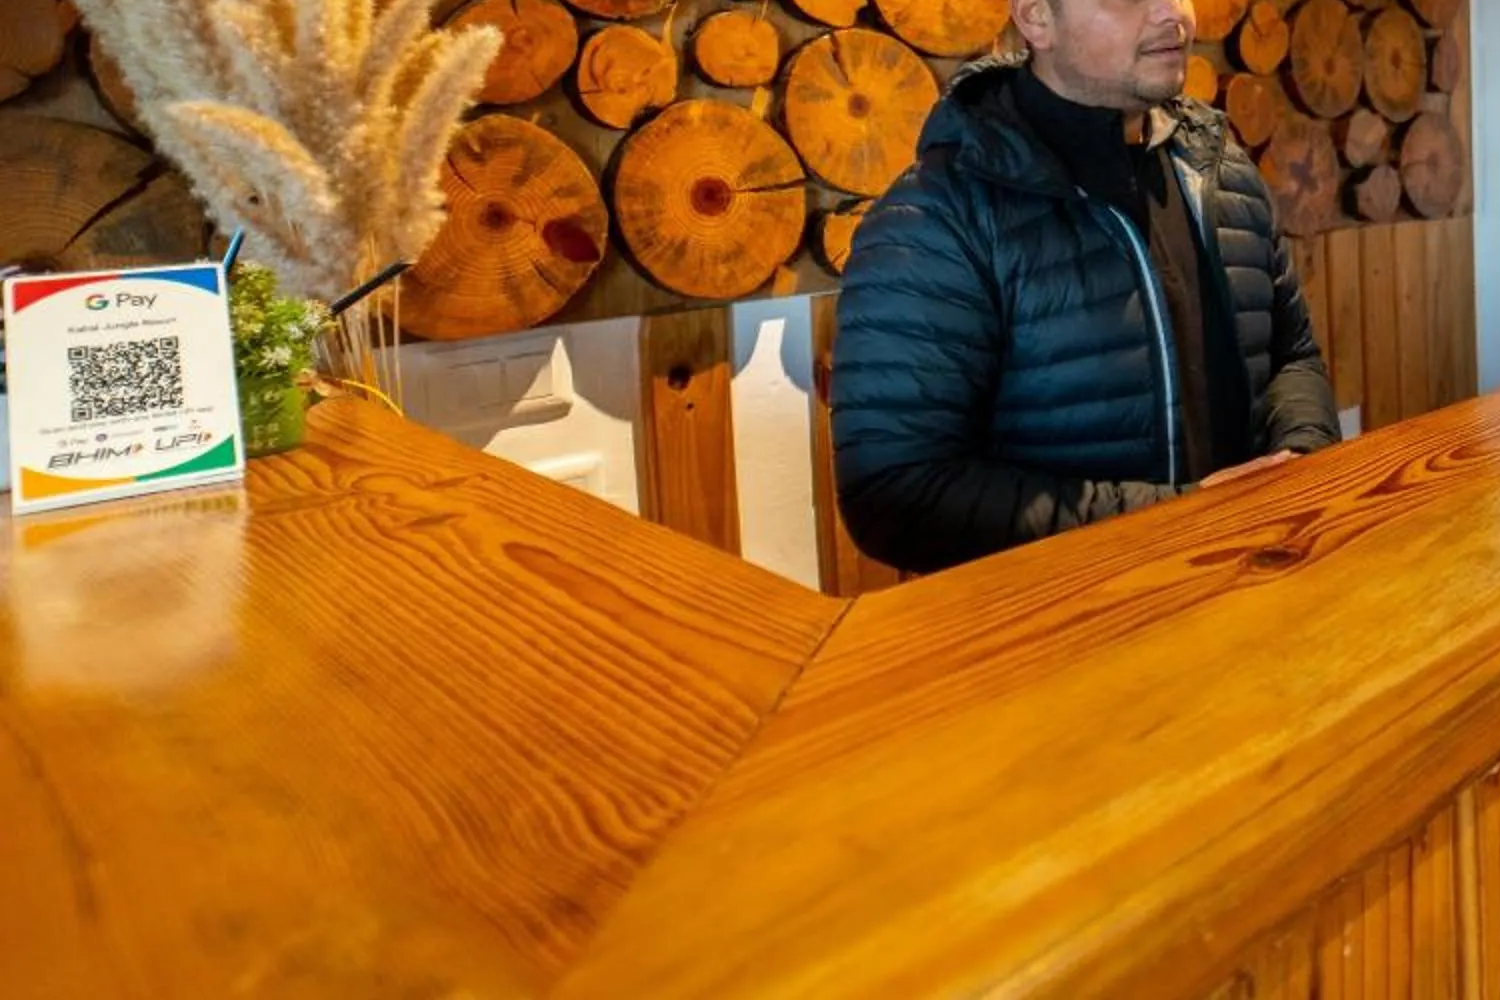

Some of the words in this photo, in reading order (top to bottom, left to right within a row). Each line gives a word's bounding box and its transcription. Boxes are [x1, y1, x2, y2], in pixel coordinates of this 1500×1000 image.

[117, 292, 157, 310] Pay
[49, 444, 133, 468] BHIM
[155, 432, 204, 450] UPI
